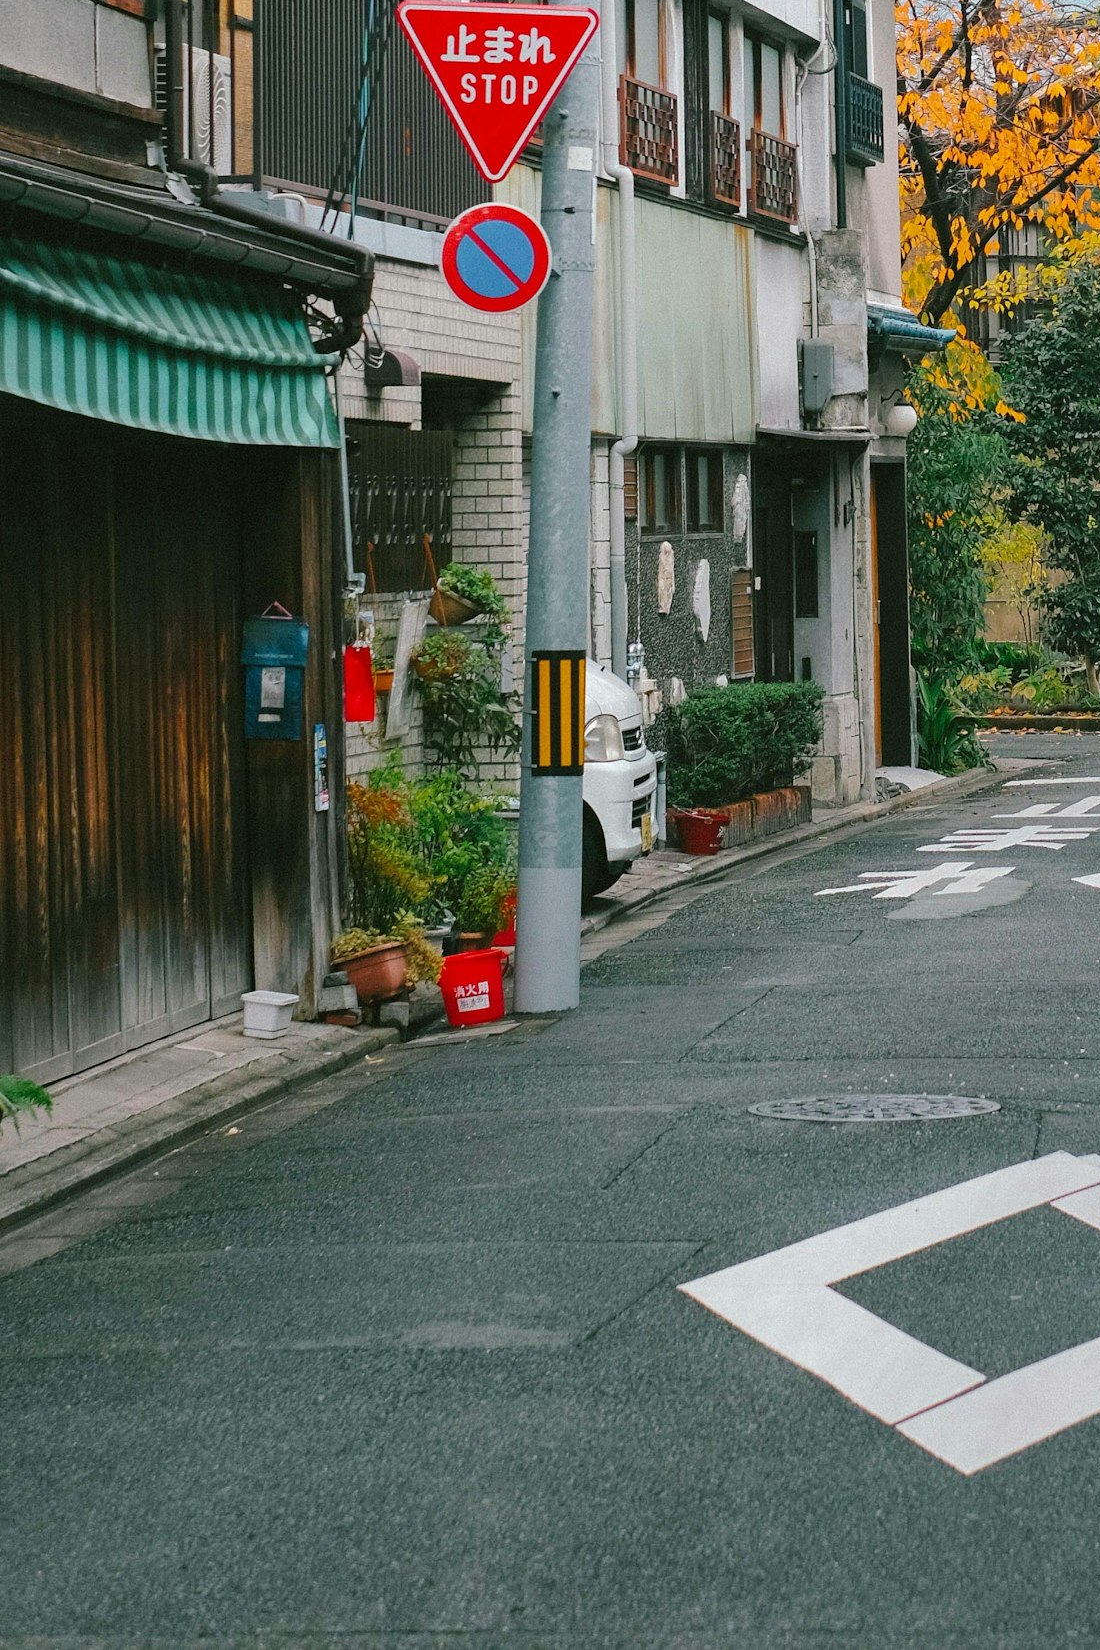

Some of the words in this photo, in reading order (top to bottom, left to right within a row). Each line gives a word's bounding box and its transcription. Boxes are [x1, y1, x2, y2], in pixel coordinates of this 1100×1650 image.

[440, 24, 556, 64] 止まれ
[460, 73, 539, 105] STOP
[453, 980, 490, 998] 消火用
